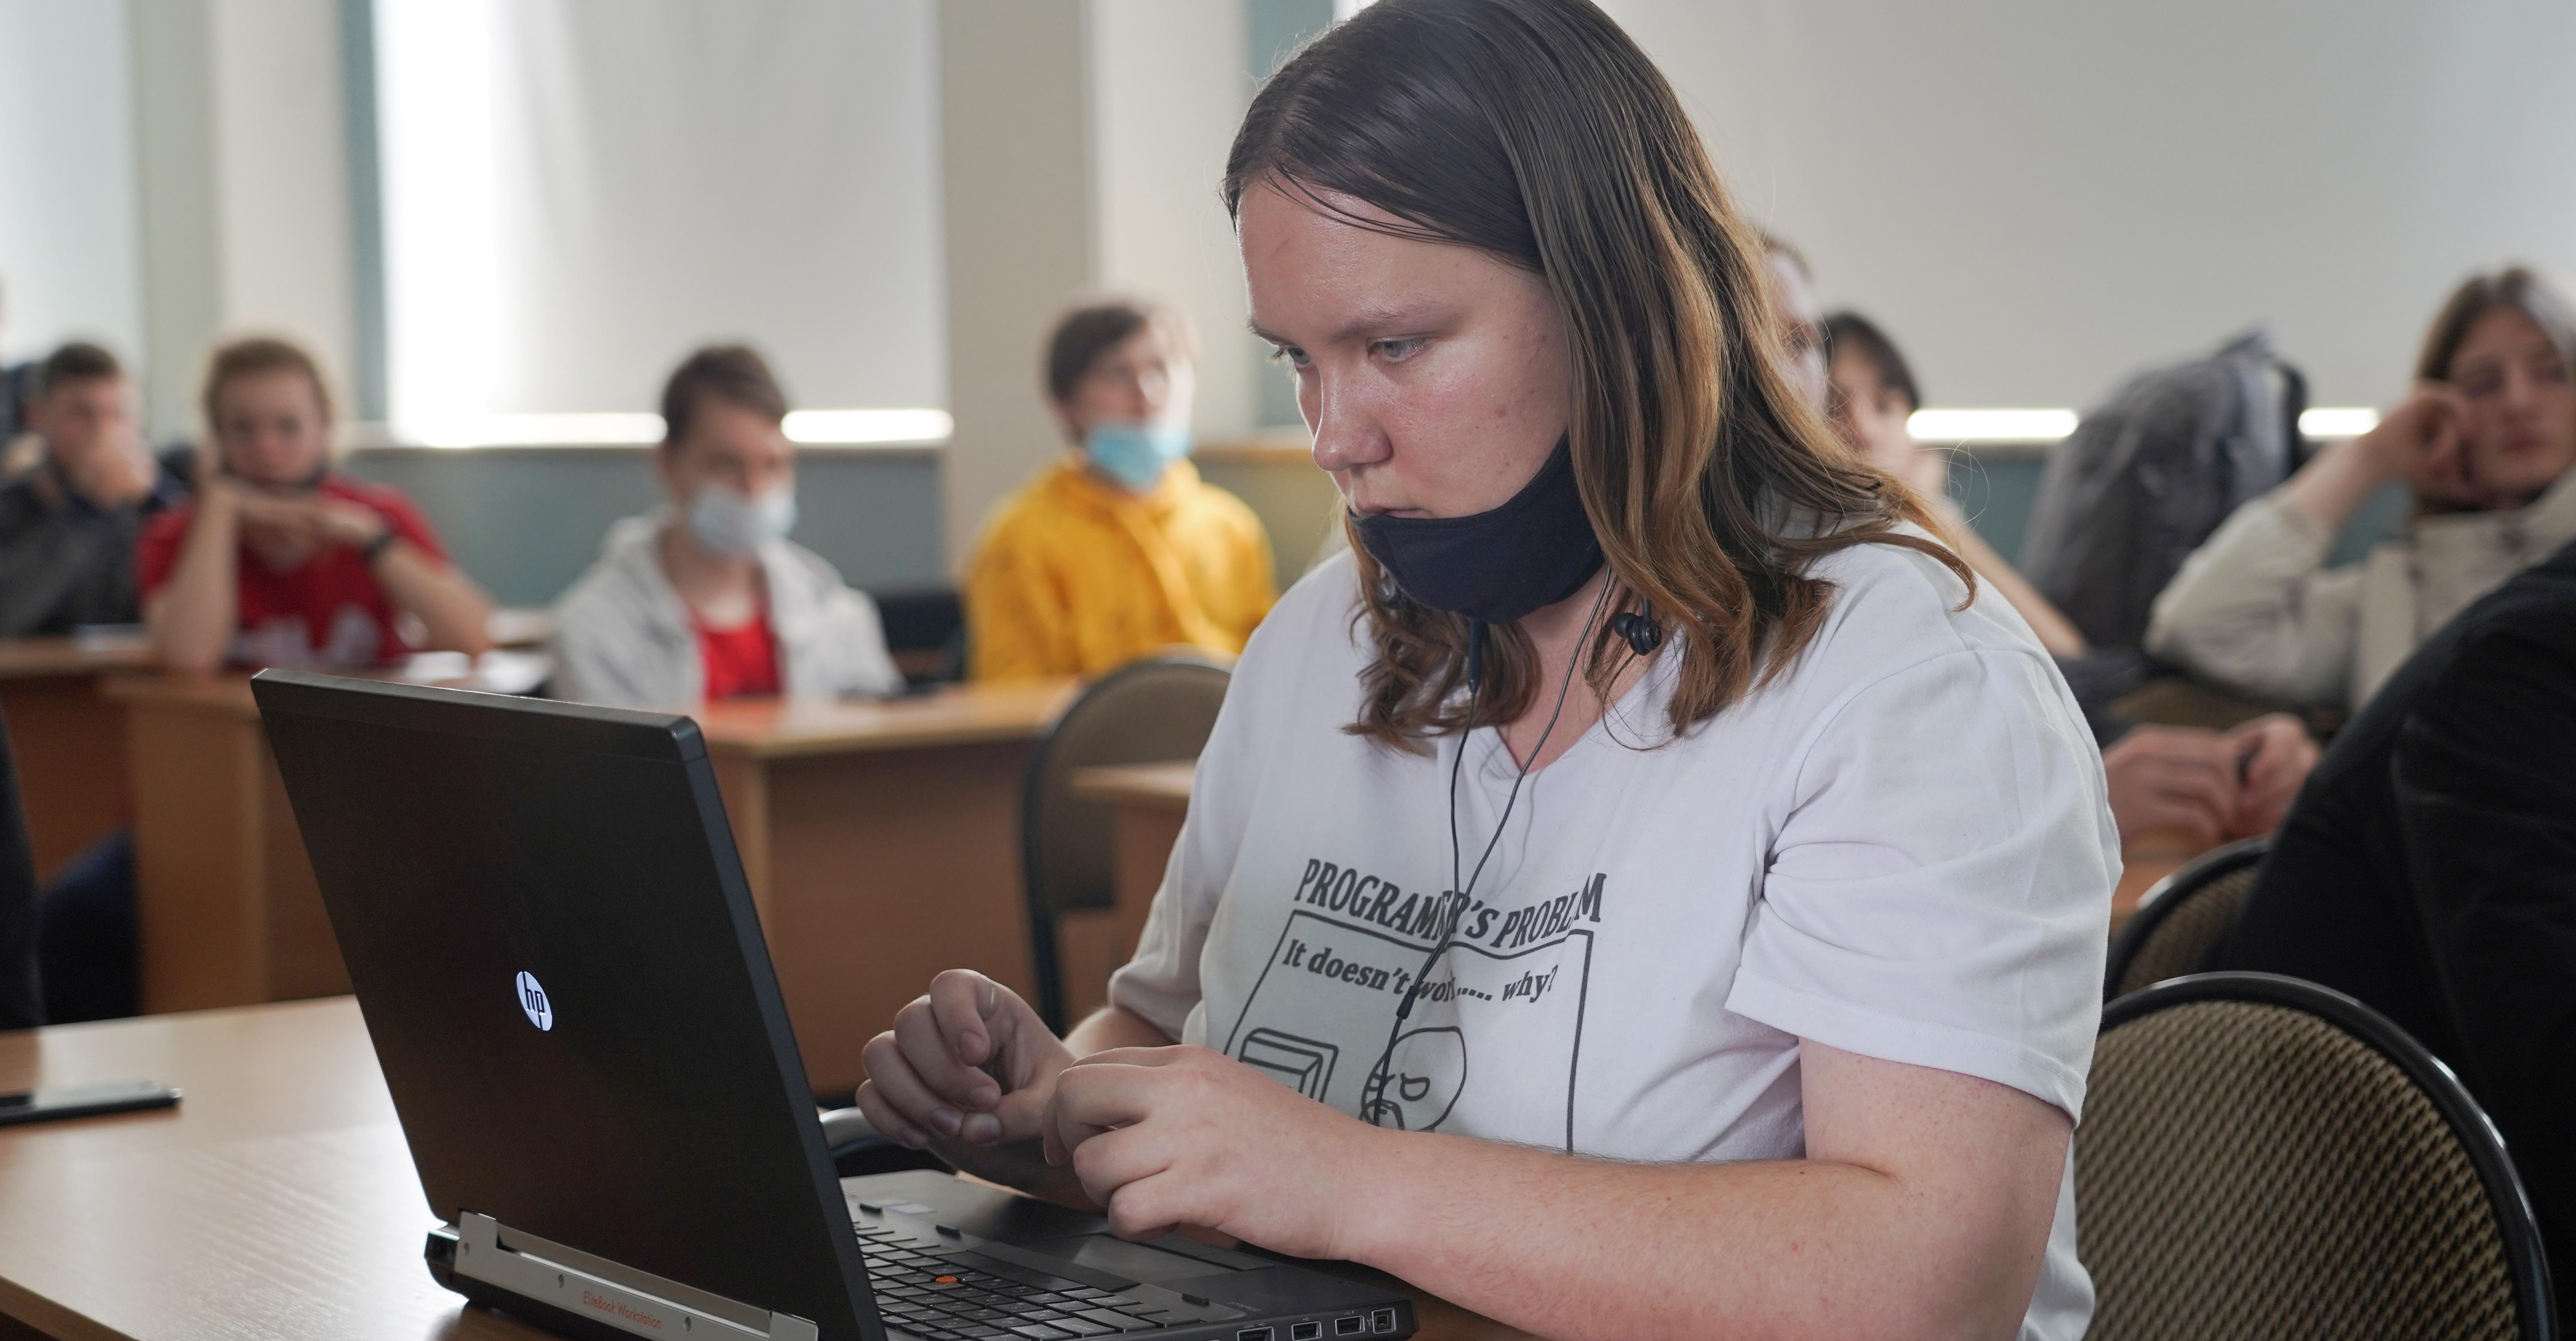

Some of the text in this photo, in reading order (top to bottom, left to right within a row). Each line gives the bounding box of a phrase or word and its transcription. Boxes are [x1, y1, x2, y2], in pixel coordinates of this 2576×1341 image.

[1489, 872, 1607, 949] PROBLM
[522, 971, 545, 1031] hp
[1282, 939, 1307, 967] It
[1307, 946, 1411, 994] doesn't
[1502, 964, 1558, 1003] why?
[583, 1290, 662, 1329] EliteBook Workstation
